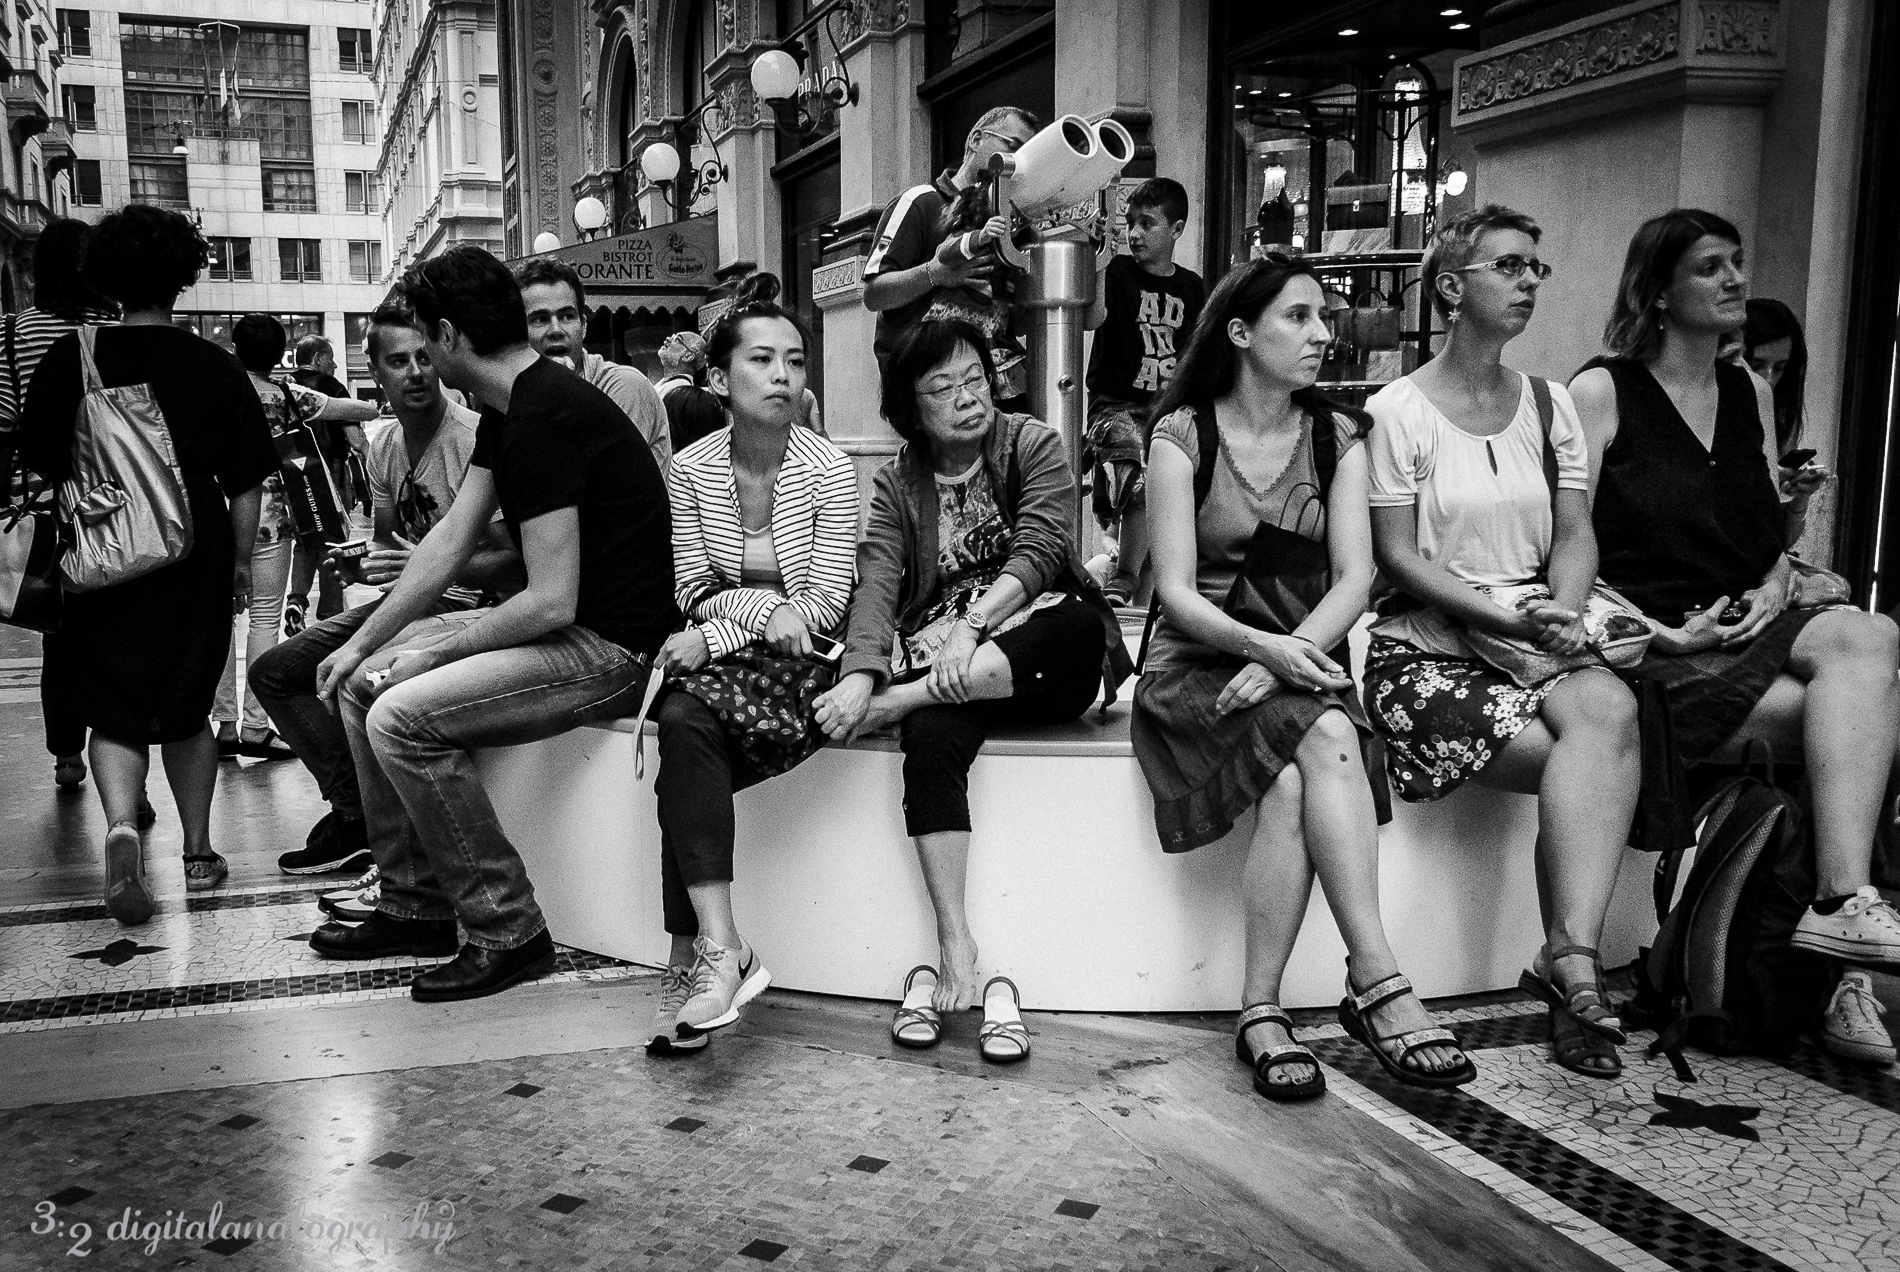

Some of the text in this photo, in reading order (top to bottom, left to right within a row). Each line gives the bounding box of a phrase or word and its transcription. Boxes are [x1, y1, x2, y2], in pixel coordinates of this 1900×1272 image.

[618, 239, 652, 250] PIZZA
[603, 252, 654, 263] BISTROT
[1136, 289, 1185, 330] AD
[313, 513, 324, 532] SHOP
